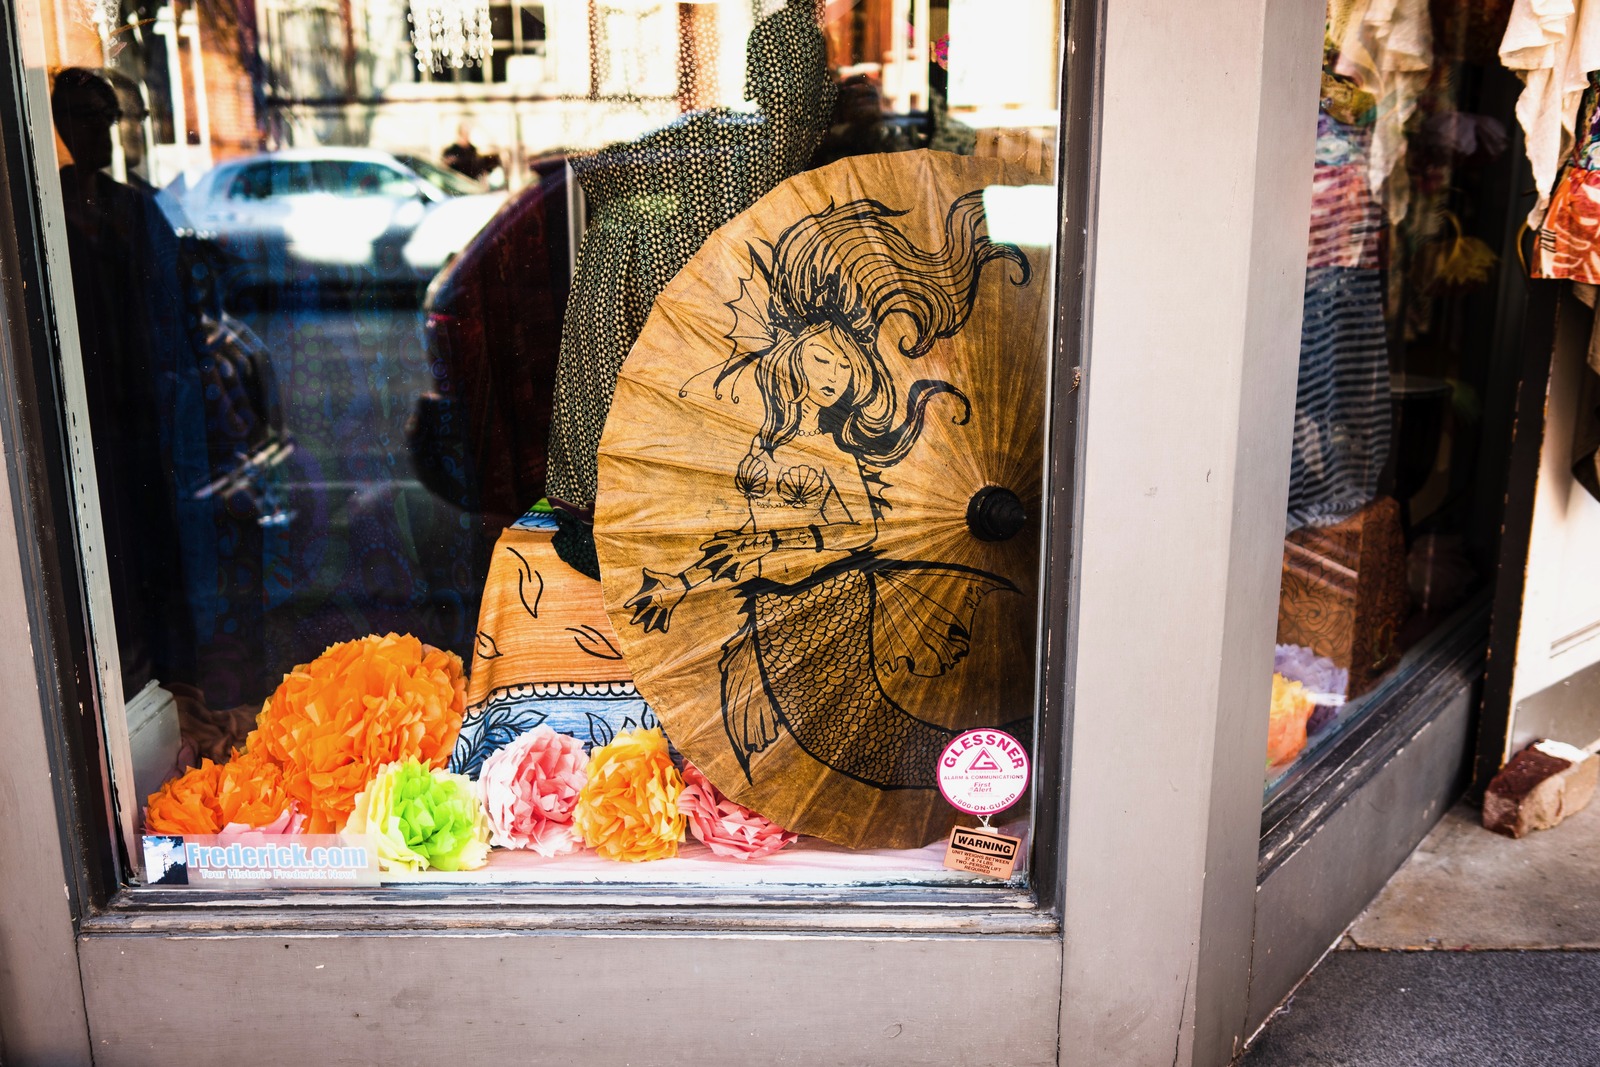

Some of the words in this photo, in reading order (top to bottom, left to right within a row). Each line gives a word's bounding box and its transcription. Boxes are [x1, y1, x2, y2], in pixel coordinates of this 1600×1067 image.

[944, 734, 1024, 769] GLESSNER
[958, 835, 1011, 854] WARNING
[185, 842, 368, 868] Frederick.com
[985, 856, 1010, 865] BETWEEN
[200, 867, 225, 880] Tour
[227, 868, 272, 880] Historic
[273, 868, 327, 880] Frederick
